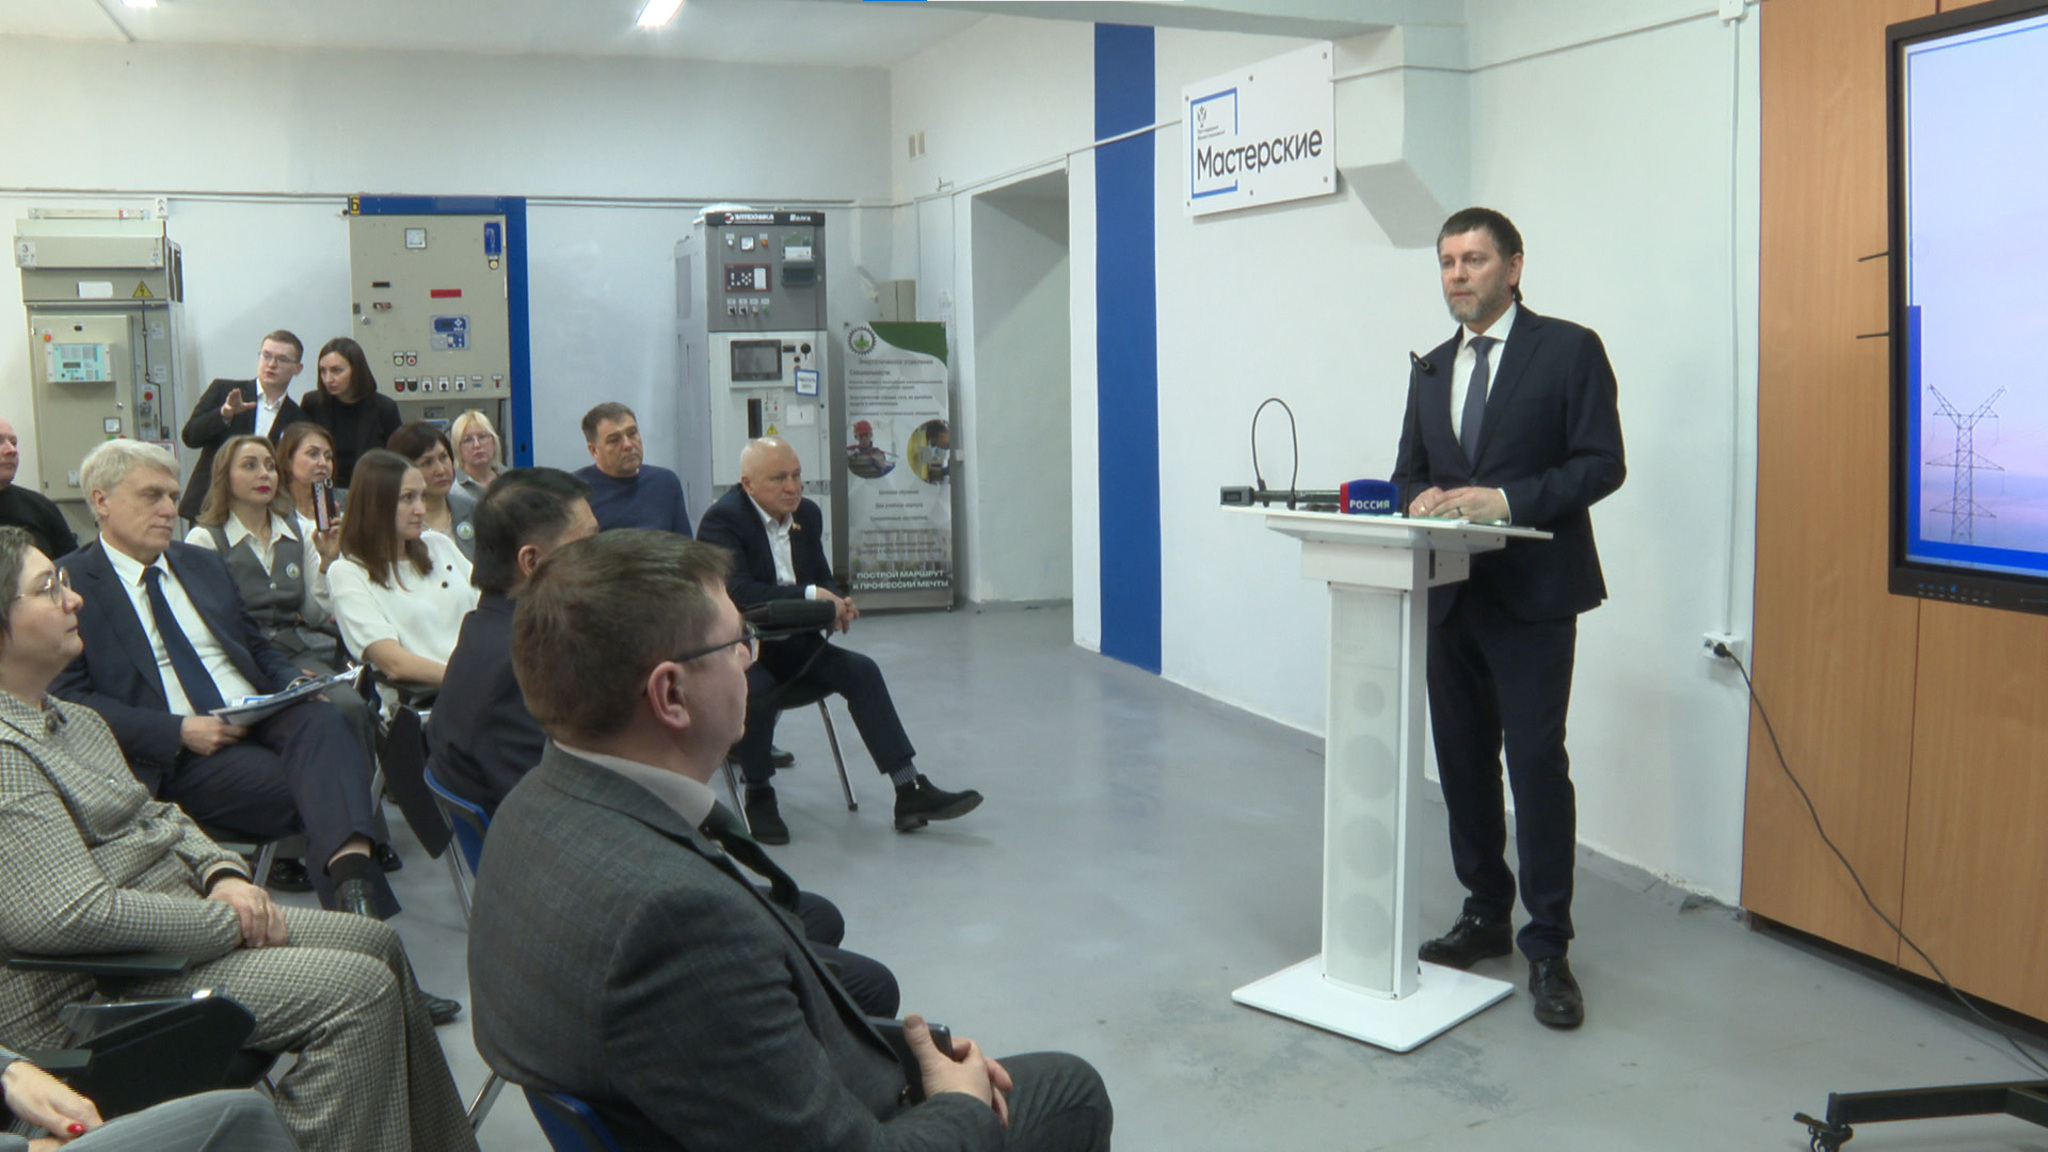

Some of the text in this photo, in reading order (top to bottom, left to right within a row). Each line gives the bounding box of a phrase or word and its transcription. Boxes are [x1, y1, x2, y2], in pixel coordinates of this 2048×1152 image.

[1197, 129, 1323, 180] Мастерские
[1349, 499, 1390, 510] РОССИЯ
[856, 570, 944, 579] ПОСТРОЙ МАРШРУТ
[860, 581, 916, 590] ПРОФЕССИИ
[917, 579, 949, 588] МЕЧТЫ
